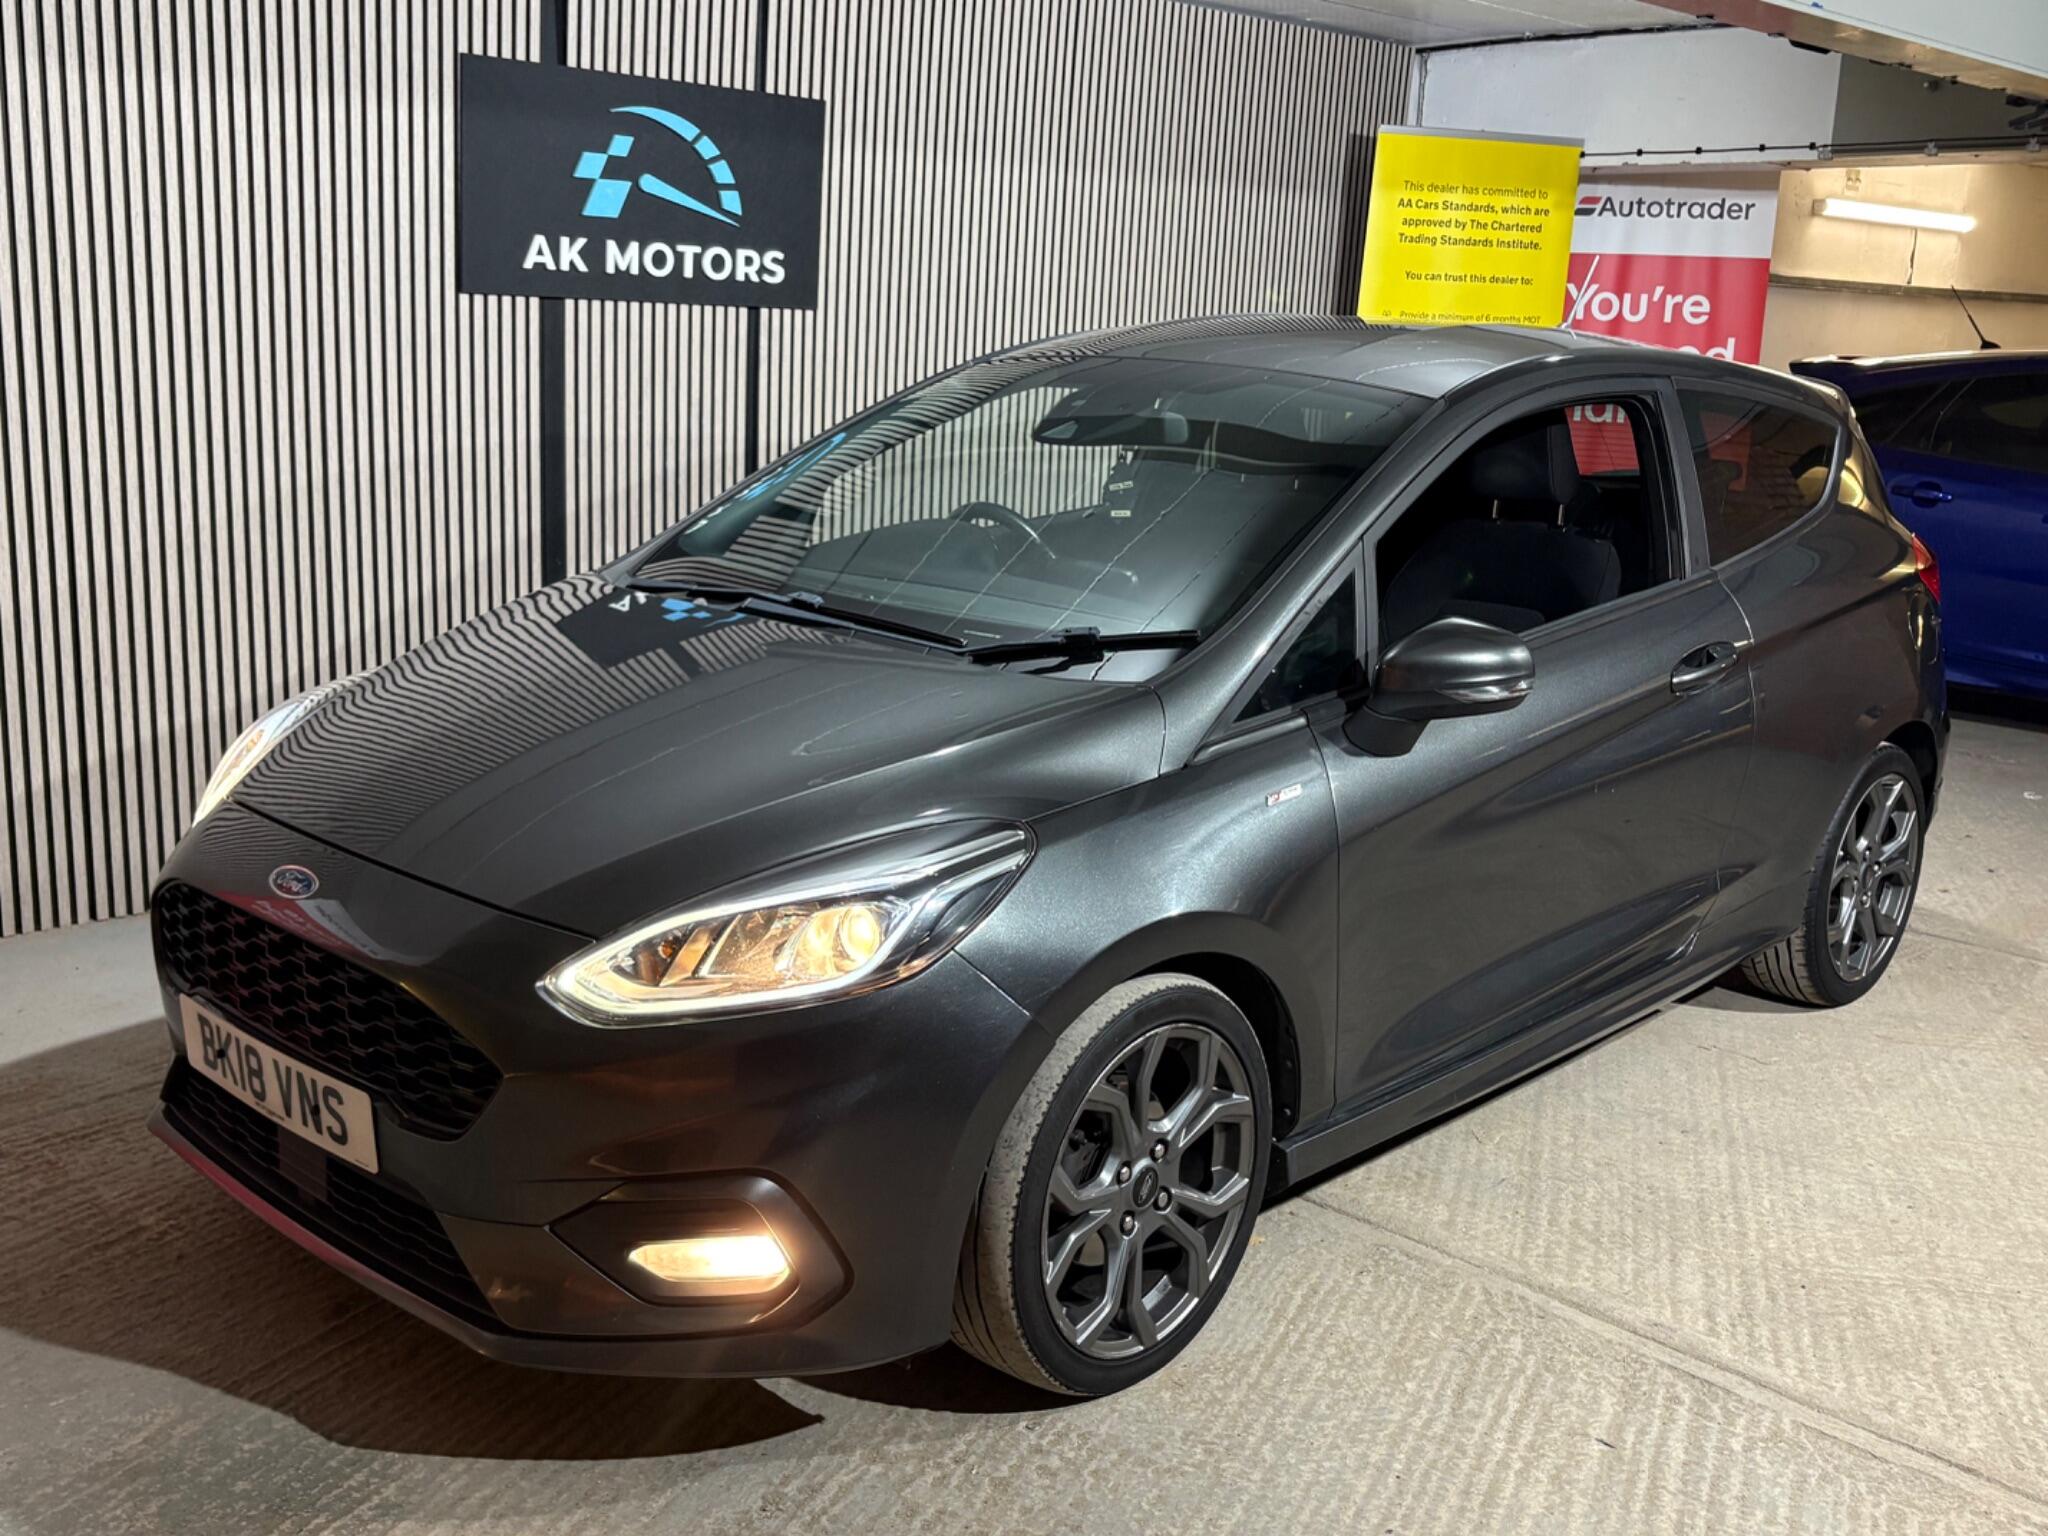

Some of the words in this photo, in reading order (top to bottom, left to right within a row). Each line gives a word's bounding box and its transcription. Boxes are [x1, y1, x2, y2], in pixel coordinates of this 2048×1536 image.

[1404, 180, 1425, 191] This
[1427, 182, 1460, 194] dealer
[1462, 184, 1479, 195] has
[1482, 187, 1536, 199] committed
[1539, 190, 1549, 199] to
[1397, 198, 1413, 208] AA
[1415, 199, 1439, 210] Cars
[1442, 200, 1498, 214] Standards,
[1501, 204, 1532, 216] which
[1534, 208, 1550, 217] are
[1598, 196, 1756, 220] Autotrader
[1402, 217, 1452, 228] approved
[1455, 218, 1468, 231] by
[1470, 219, 1488, 230] The
[1491, 220, 1543, 233] Chartered
[1398, 232, 1438, 246] Trading
[1440, 235, 1493, 248] Standards
[1496, 238, 1543, 250] Institute.
[522, 234, 589, 273] AK
[604, 239, 786, 284] MOTORS
[1405, 270, 1422, 280] You
[1424, 273, 1442, 281] can
[1444, 272, 1467, 282] trust
[1470, 273, 1487, 283] this
[1489, 274, 1519, 285] dealer
[1521, 276, 1534, 286] to:
[1567, 282, 1711, 325] You're
[1400, 310, 1429, 320] Provide
[1438, 312, 1475, 321] minimum
[1476, 313, 1484, 322] of
[1492, 314, 1521, 323] months
[1523, 315, 1541, 324] MOT
[196, 1011, 267, 1103] BK18
[272, 1057, 348, 1147] VNS
